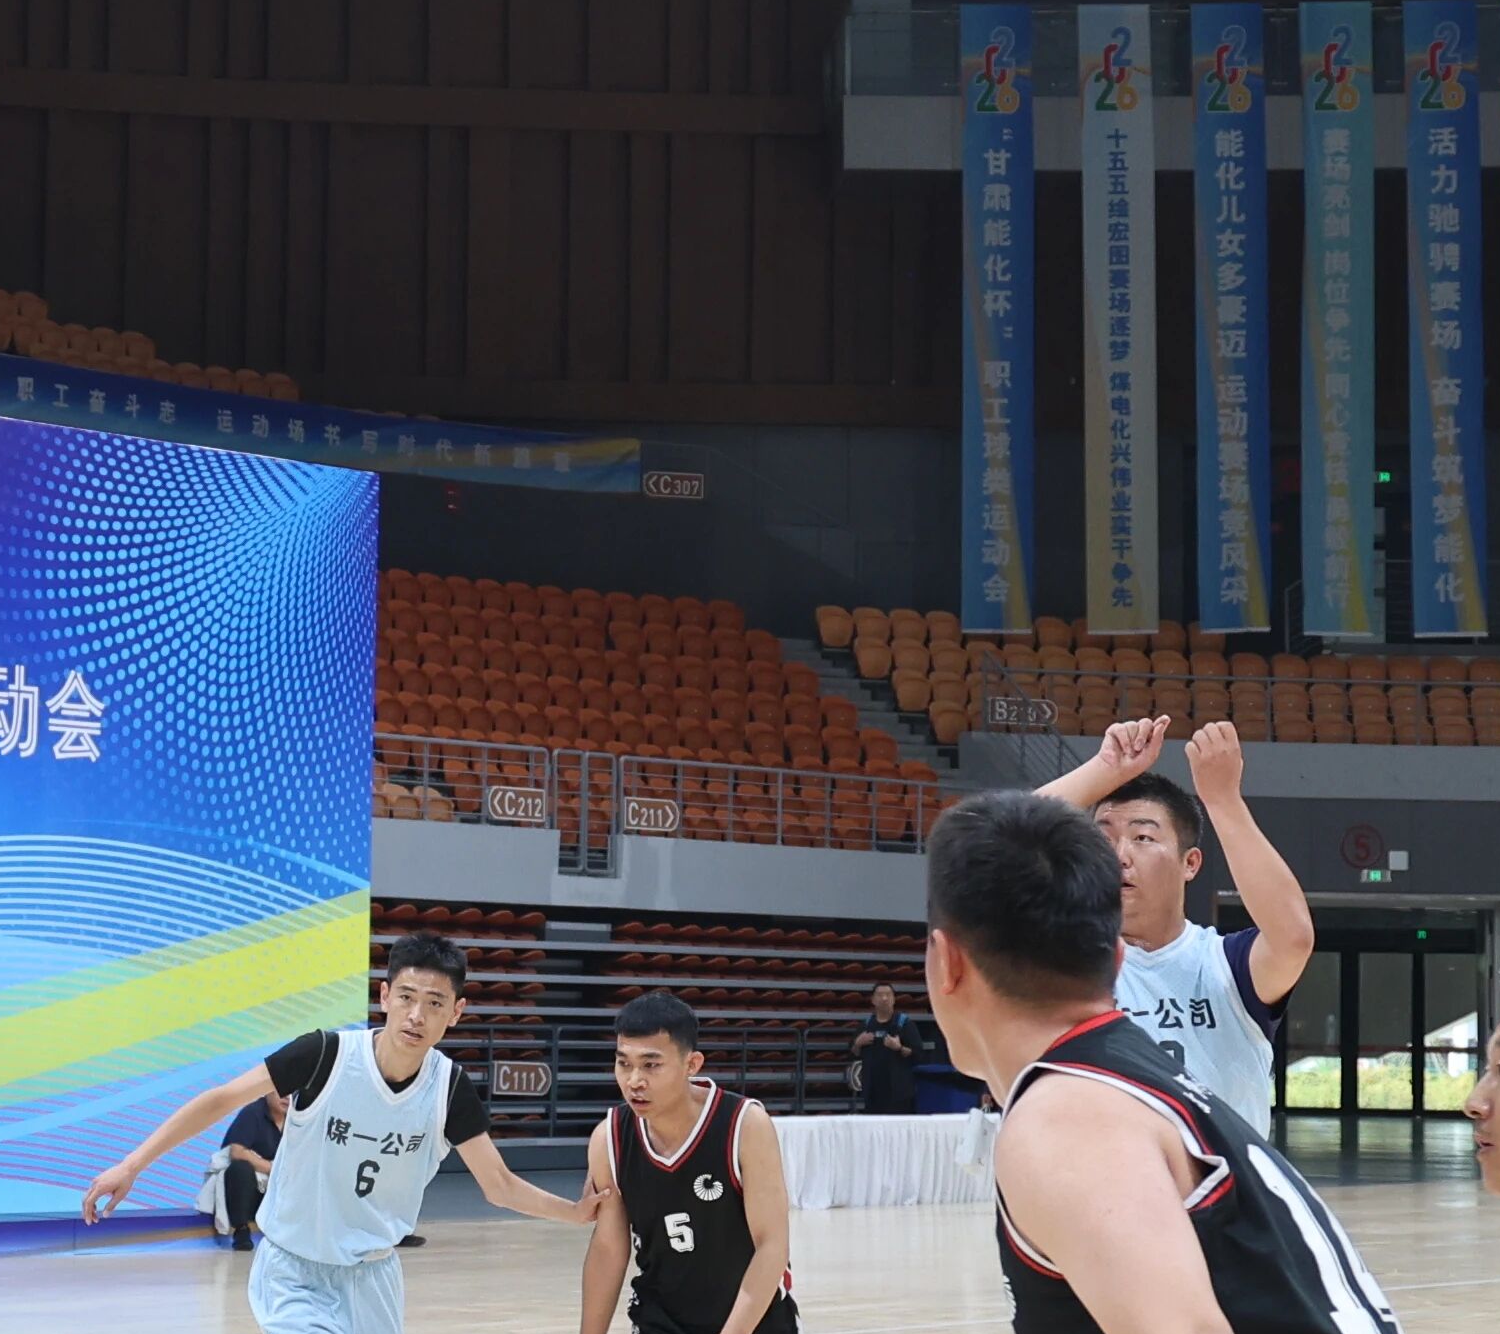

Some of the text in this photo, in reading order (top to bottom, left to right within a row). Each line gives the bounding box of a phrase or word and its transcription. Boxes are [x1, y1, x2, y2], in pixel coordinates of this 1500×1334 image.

[1428, 127, 1463, 351] 活力驰骋赛场
[660, 473, 701, 498] C307
[504, 791, 542, 818] C212
[628, 801, 663, 828] C211
[1121, 996, 1217, 1030] 一公司
[500, 1065, 537, 1091] C111
[326, 1116, 426, 1157] 煤一公司
[354, 1159, 381, 1198] 6
[664, 1213, 696, 1252] 5
